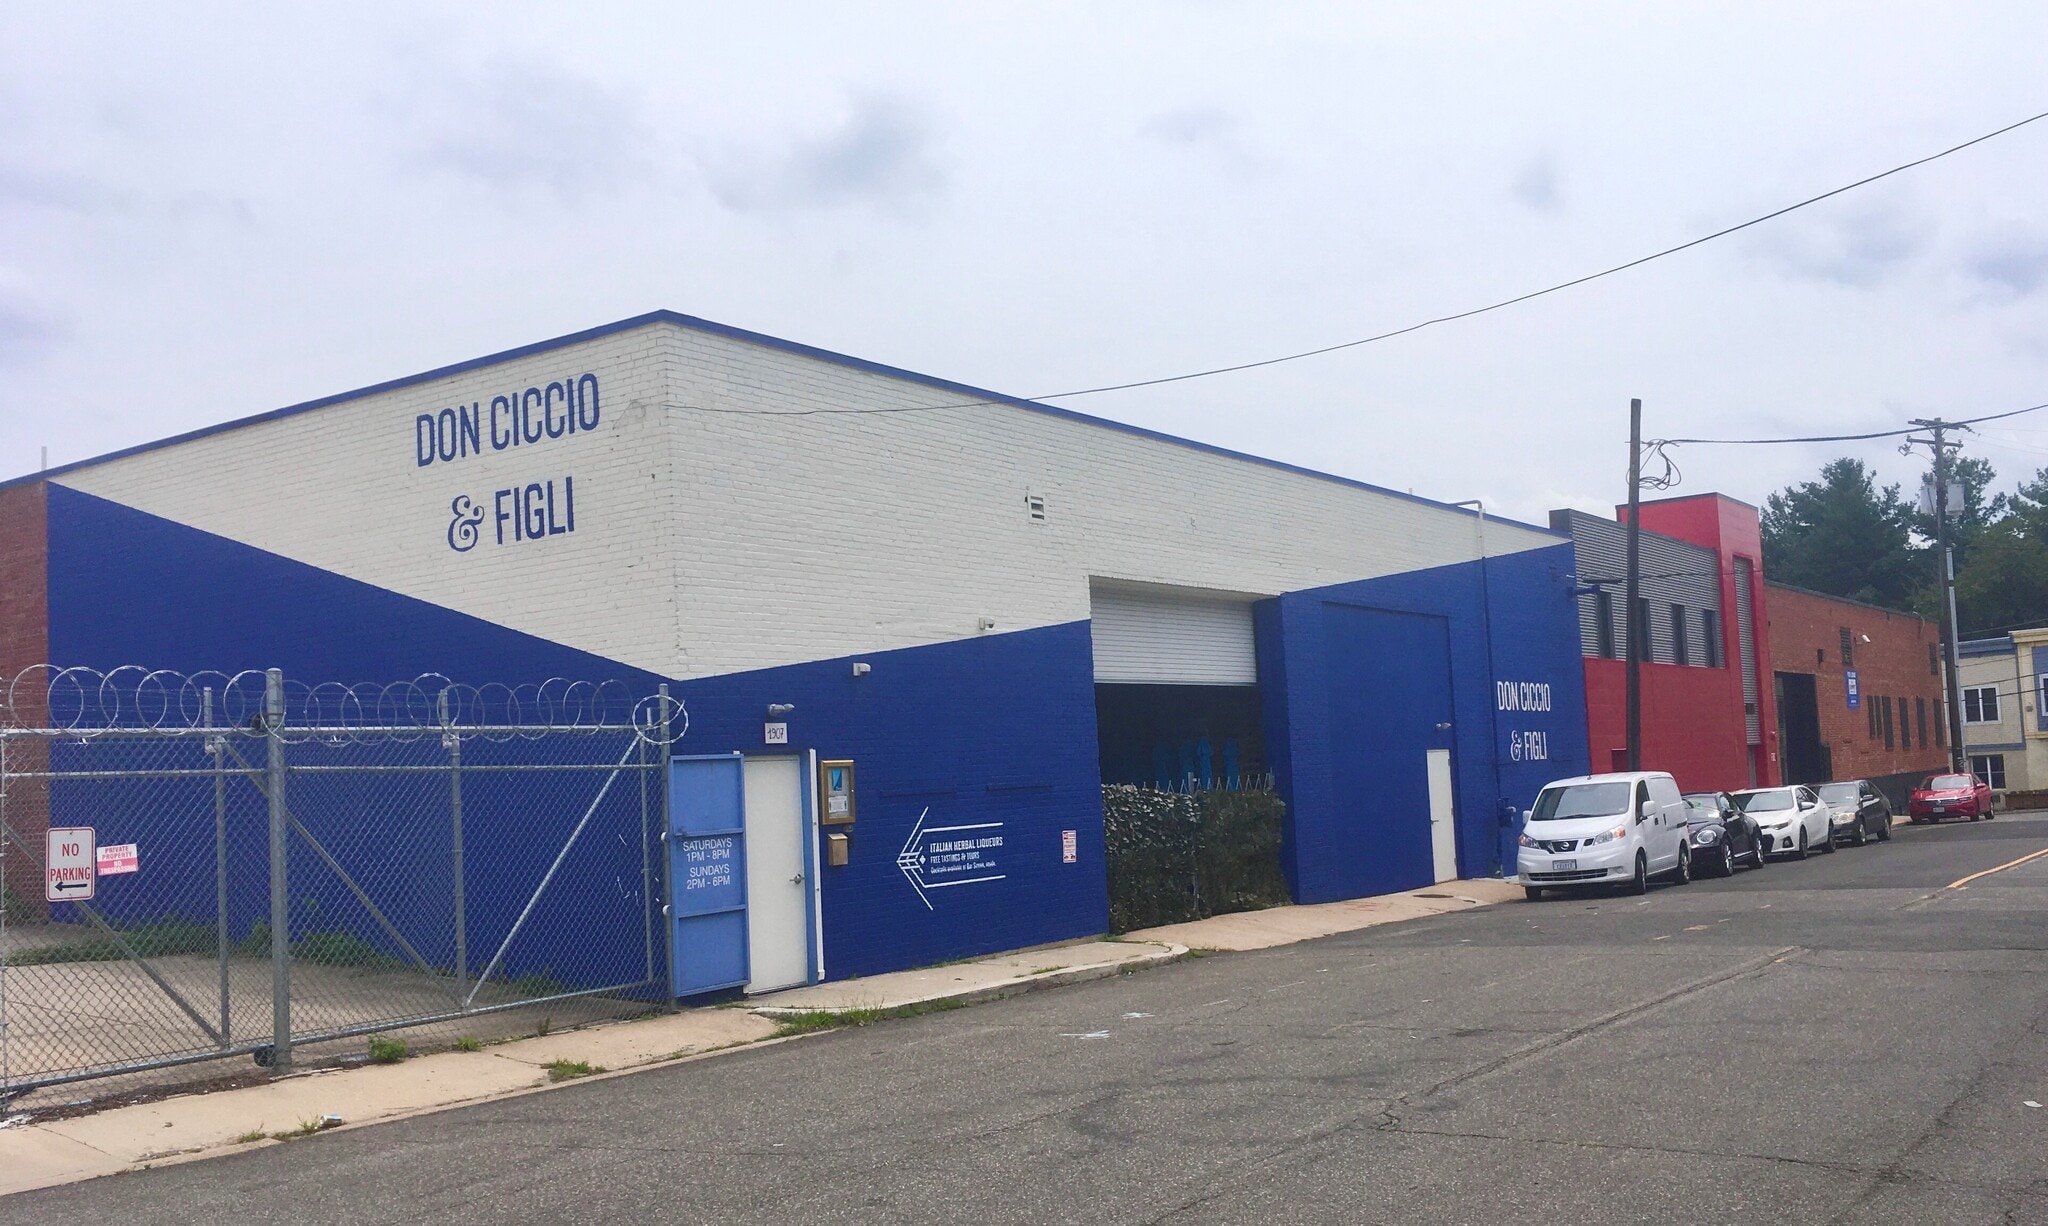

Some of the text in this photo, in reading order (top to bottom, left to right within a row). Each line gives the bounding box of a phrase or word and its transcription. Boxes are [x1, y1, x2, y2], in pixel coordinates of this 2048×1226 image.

[416, 373, 600, 467] DON CICCIO
[447, 476, 575, 552] & FIGLI
[1497, 681, 1551, 712] DON CICCIO
[767, 727, 784, 739] 1907
[1510, 730, 1547, 761] & FIGLI
[62, 843, 80, 857] NO
[105, 845, 129, 854] PRIVATE
[683, 837, 732, 852] SATURDAYS
[930, 837, 1003, 853] ITALIAN HERBAL LIQUEURS
[101, 852, 132, 860] PROPERTY
[687, 851, 705, 862] 1PM
[712, 848, 730, 860] 8PM
[930, 855, 941, 864] FREE
[50, 866, 91, 882] PARKING
[690, 863, 730, 878] SUNDAYS
[686, 878, 705, 890] 2PM
[712, 875, 730, 887] 6PM
